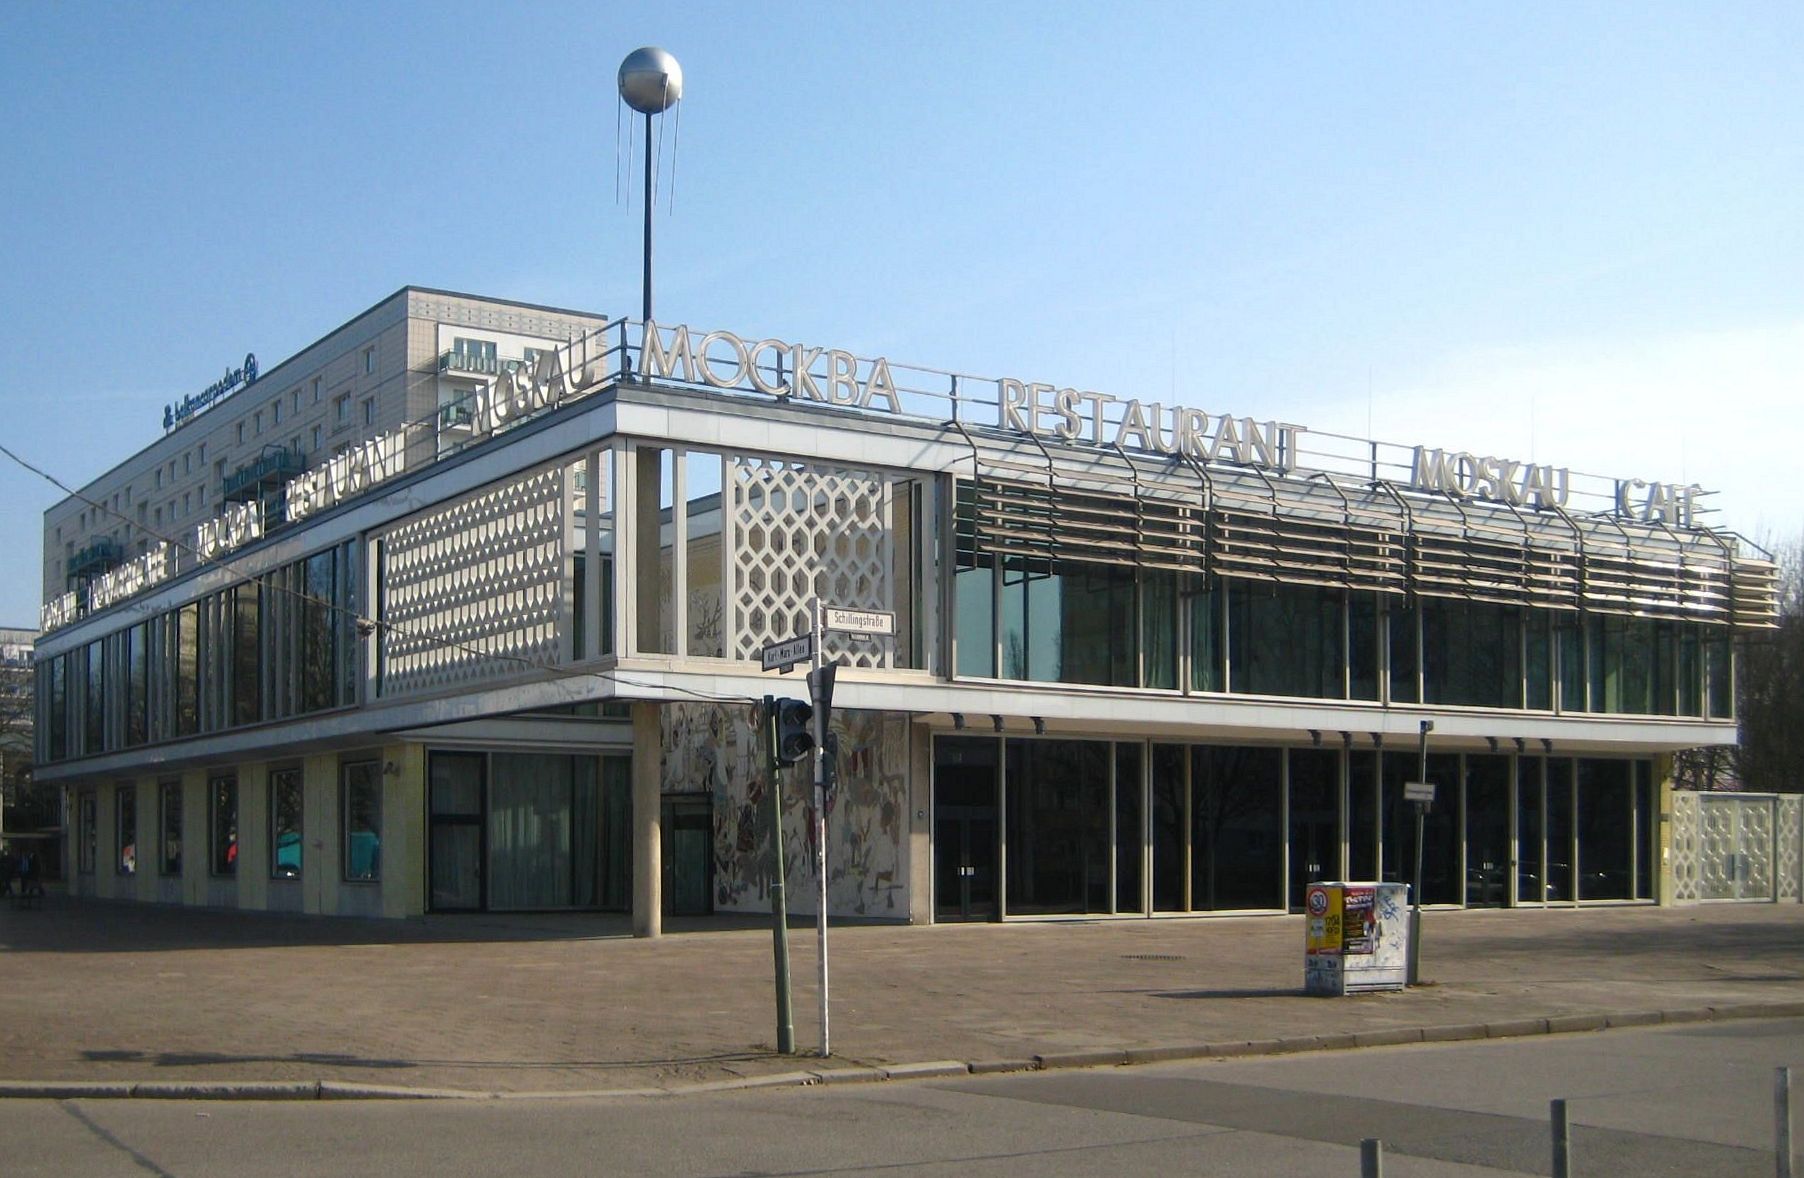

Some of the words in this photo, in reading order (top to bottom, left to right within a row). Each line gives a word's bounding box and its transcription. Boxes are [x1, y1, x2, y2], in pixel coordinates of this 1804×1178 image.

[286, 422, 410, 521] RESTAURANT
[471, 330, 596, 437] MOSKAU
[638, 319, 901, 414] МОСКВА
[998, 378, 1307, 472] RESTAURANT
[1411, 445, 1568, 507] MOSKAU
[1620, 478, 1704, 528] CAFE
[834, 611, 884, 628] Schillingstraße
